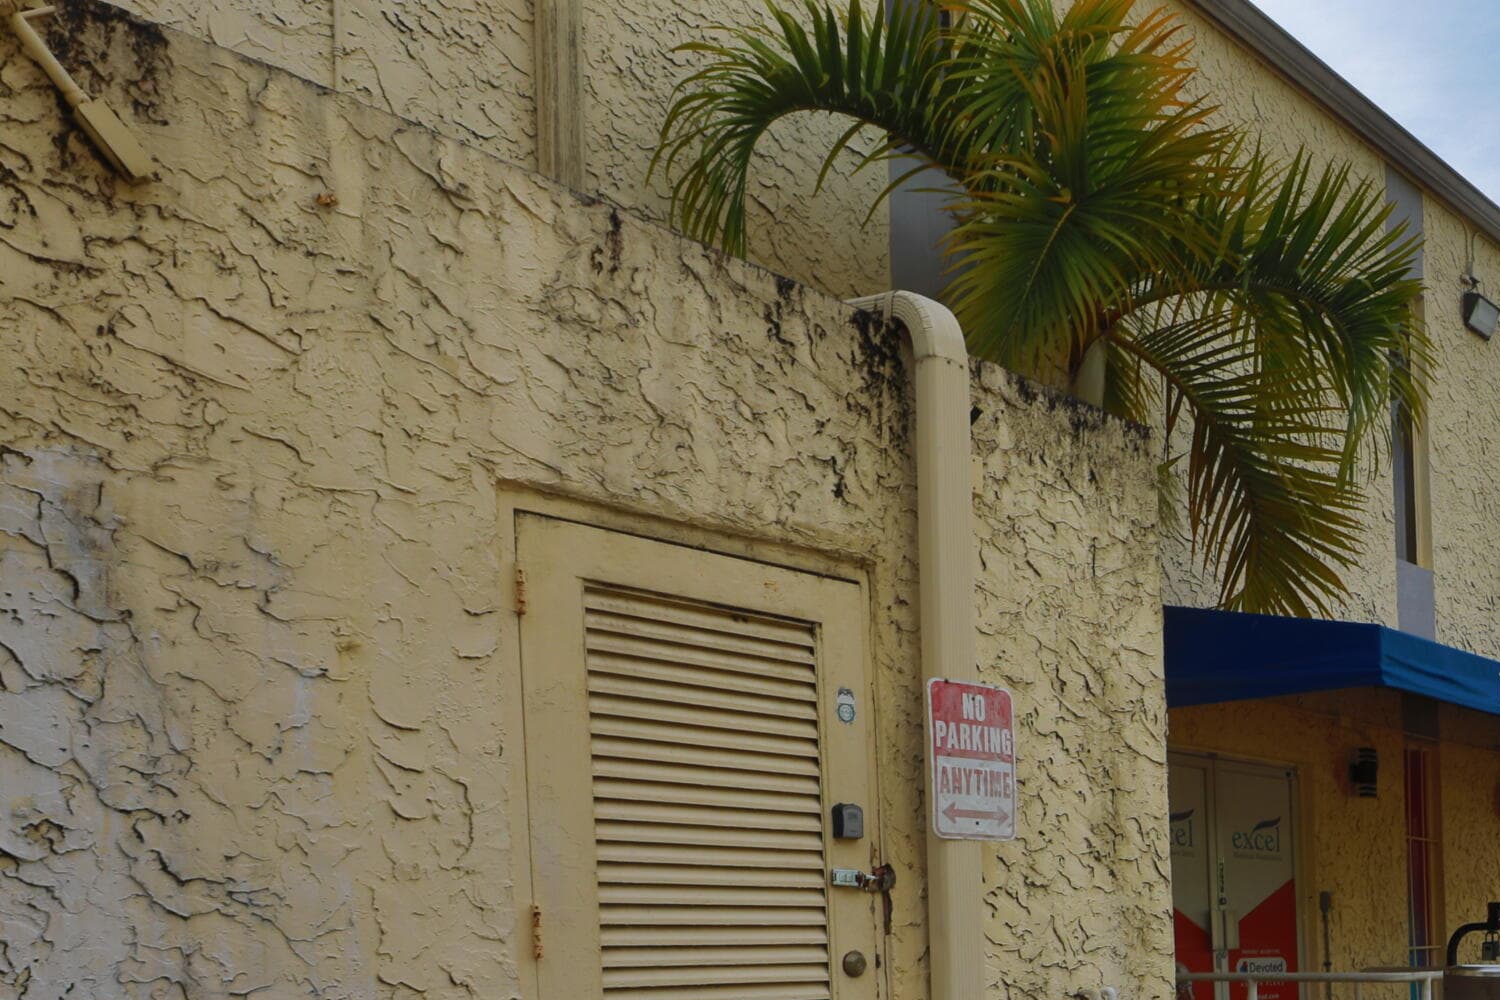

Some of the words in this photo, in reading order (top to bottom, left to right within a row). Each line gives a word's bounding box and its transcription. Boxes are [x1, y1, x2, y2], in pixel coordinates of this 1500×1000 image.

[961, 692, 986, 722] NO
[935, 720, 1012, 756] PARKING
[940, 765, 1012, 799] ANYTIME
[1232, 826, 1281, 852] excel
[1249, 961, 1284, 973] Devoted
